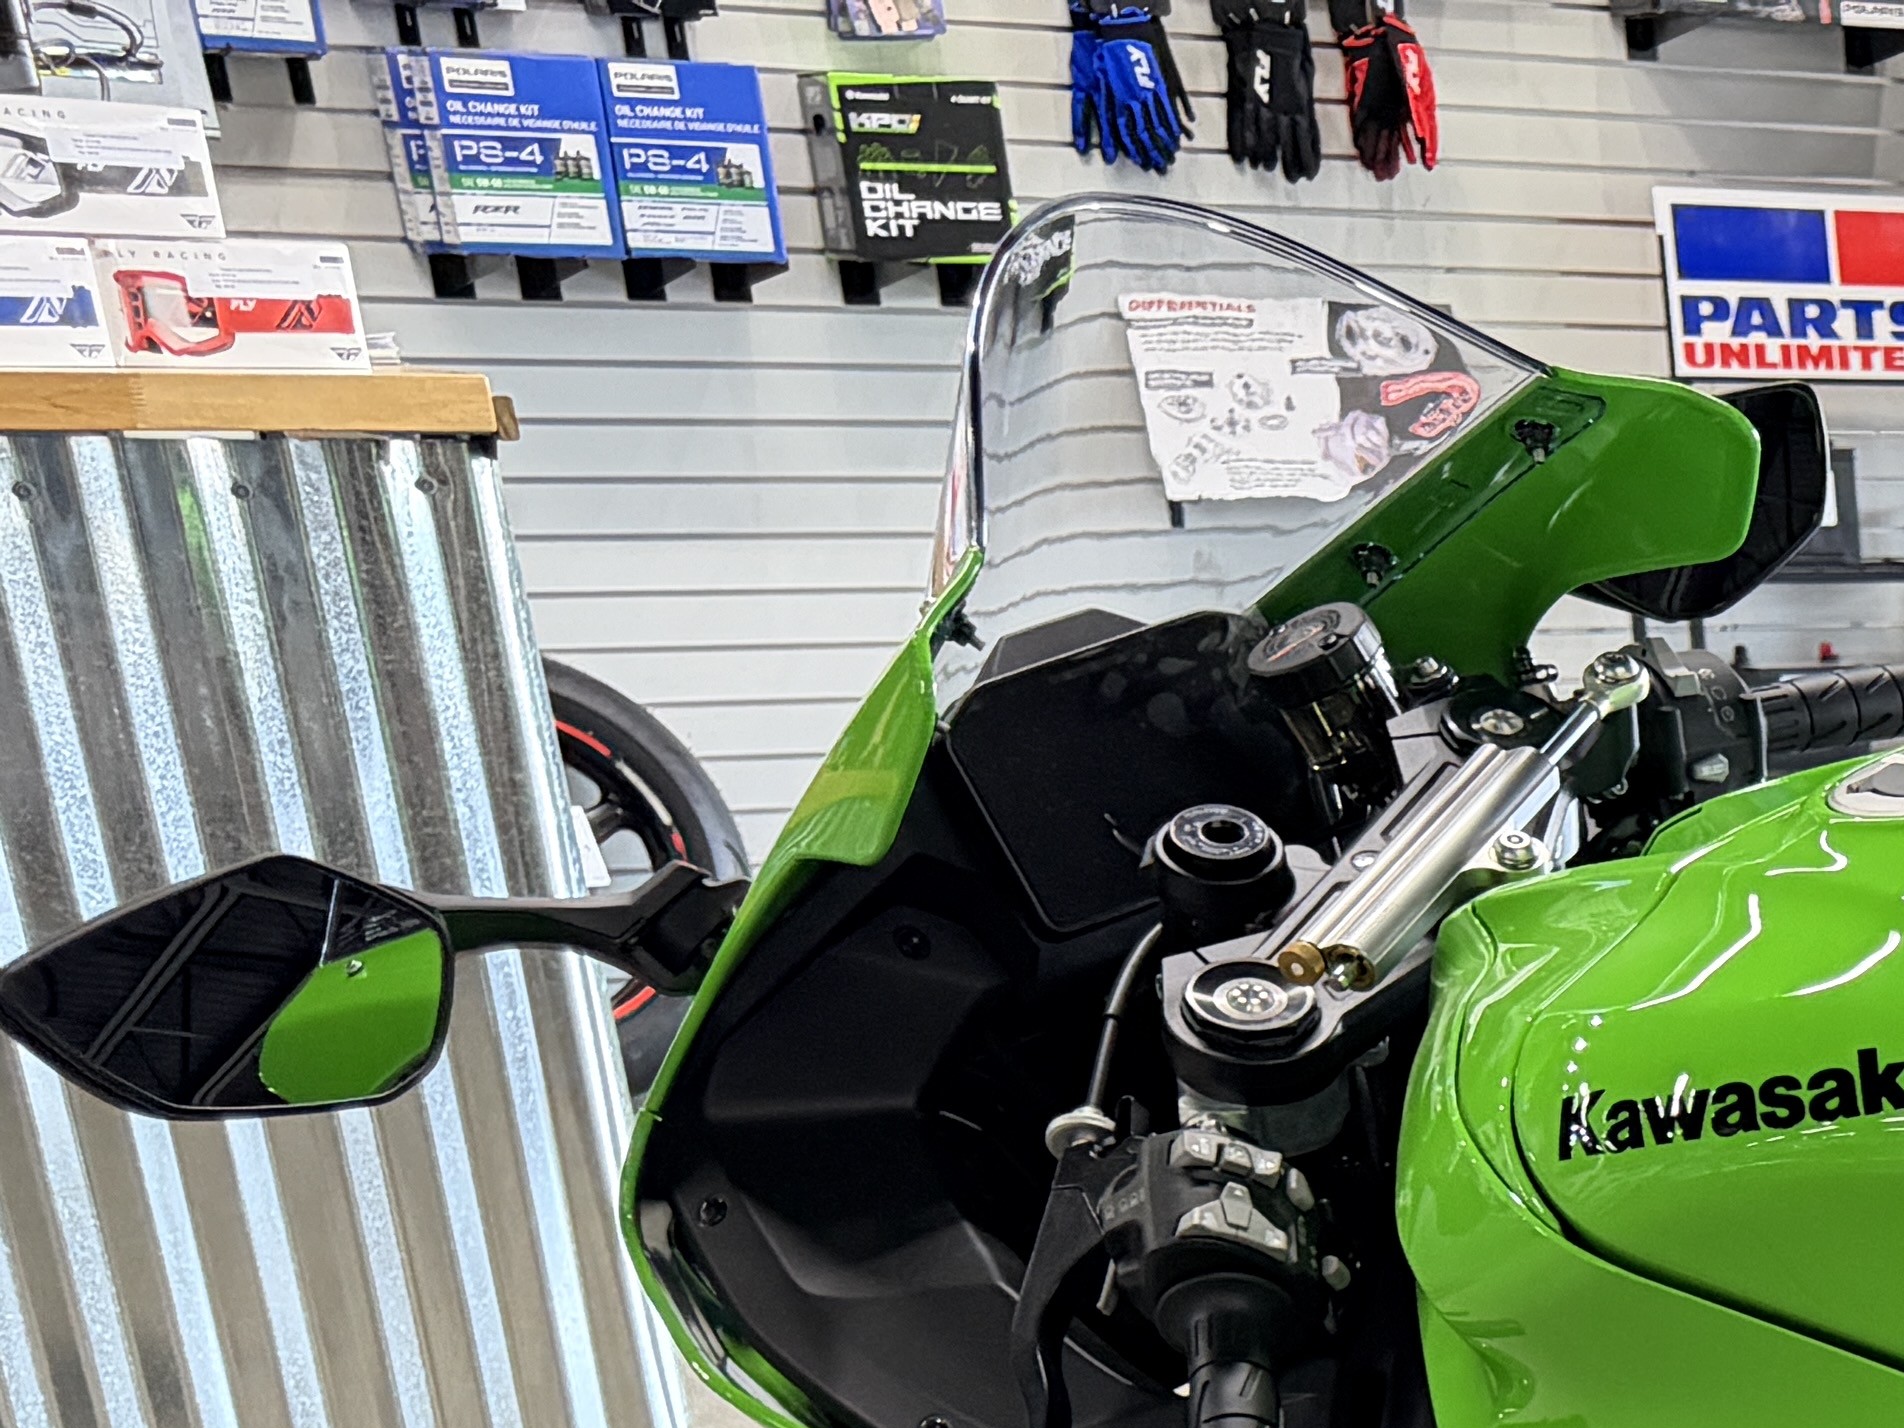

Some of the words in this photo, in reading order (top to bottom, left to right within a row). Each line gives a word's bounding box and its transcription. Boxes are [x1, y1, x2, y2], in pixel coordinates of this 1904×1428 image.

[446, 100, 466, 112] OIL
[469, 101, 516, 115] CHANGE
[519, 103, 540, 118] KIT
[614, 104, 634, 117] OIL
[635, 104, 683, 119] CHANGE
[684, 107, 705, 120] KIT
[453, 138, 545, 165] PS-4
[622, 147, 710, 173] PS-4
[858, 180, 916, 200] OIL
[861, 200, 1003, 222] CHANGE
[864, 218, 921, 238] KIT
[153, 250, 228, 262] RACING
